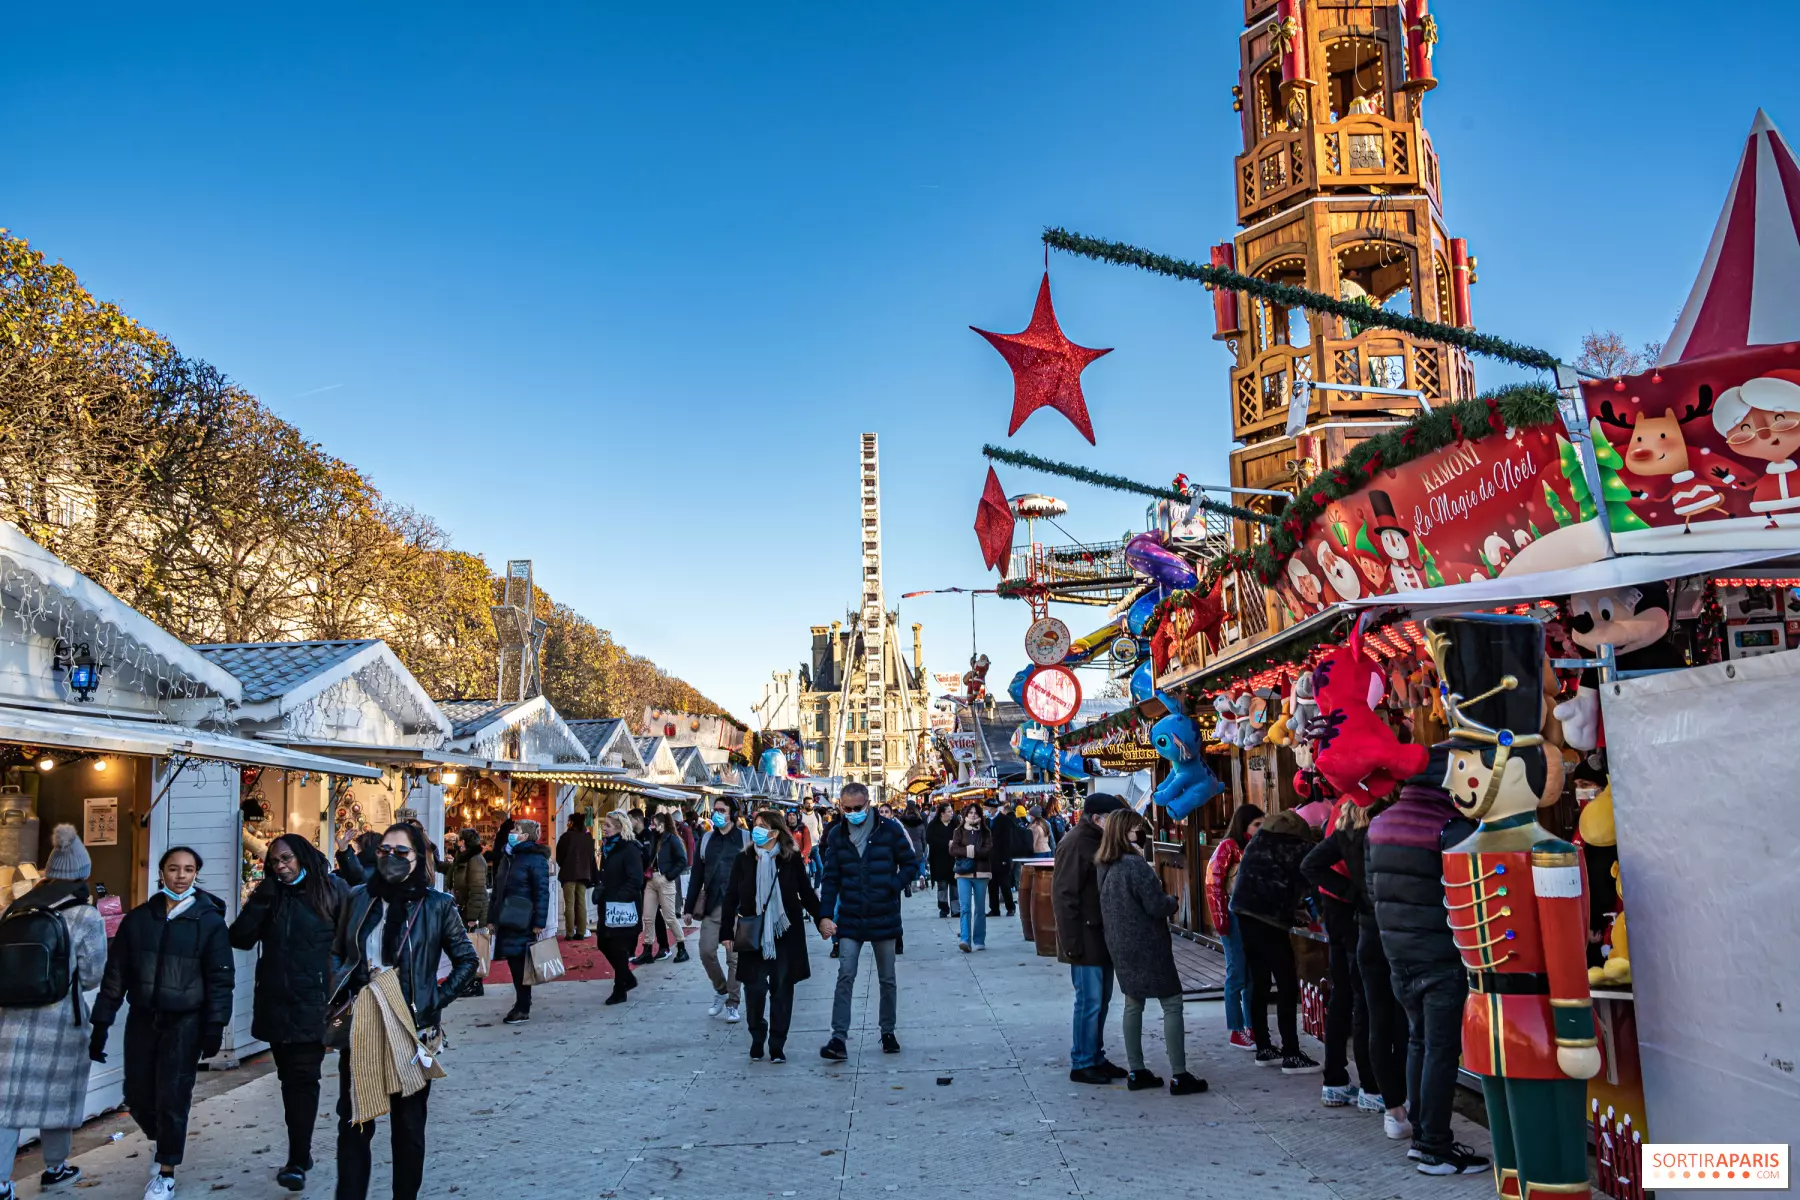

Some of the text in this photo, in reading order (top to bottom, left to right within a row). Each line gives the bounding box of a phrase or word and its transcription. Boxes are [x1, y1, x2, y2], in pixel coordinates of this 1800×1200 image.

[1414, 451, 1537, 536] La Magie de Noël
